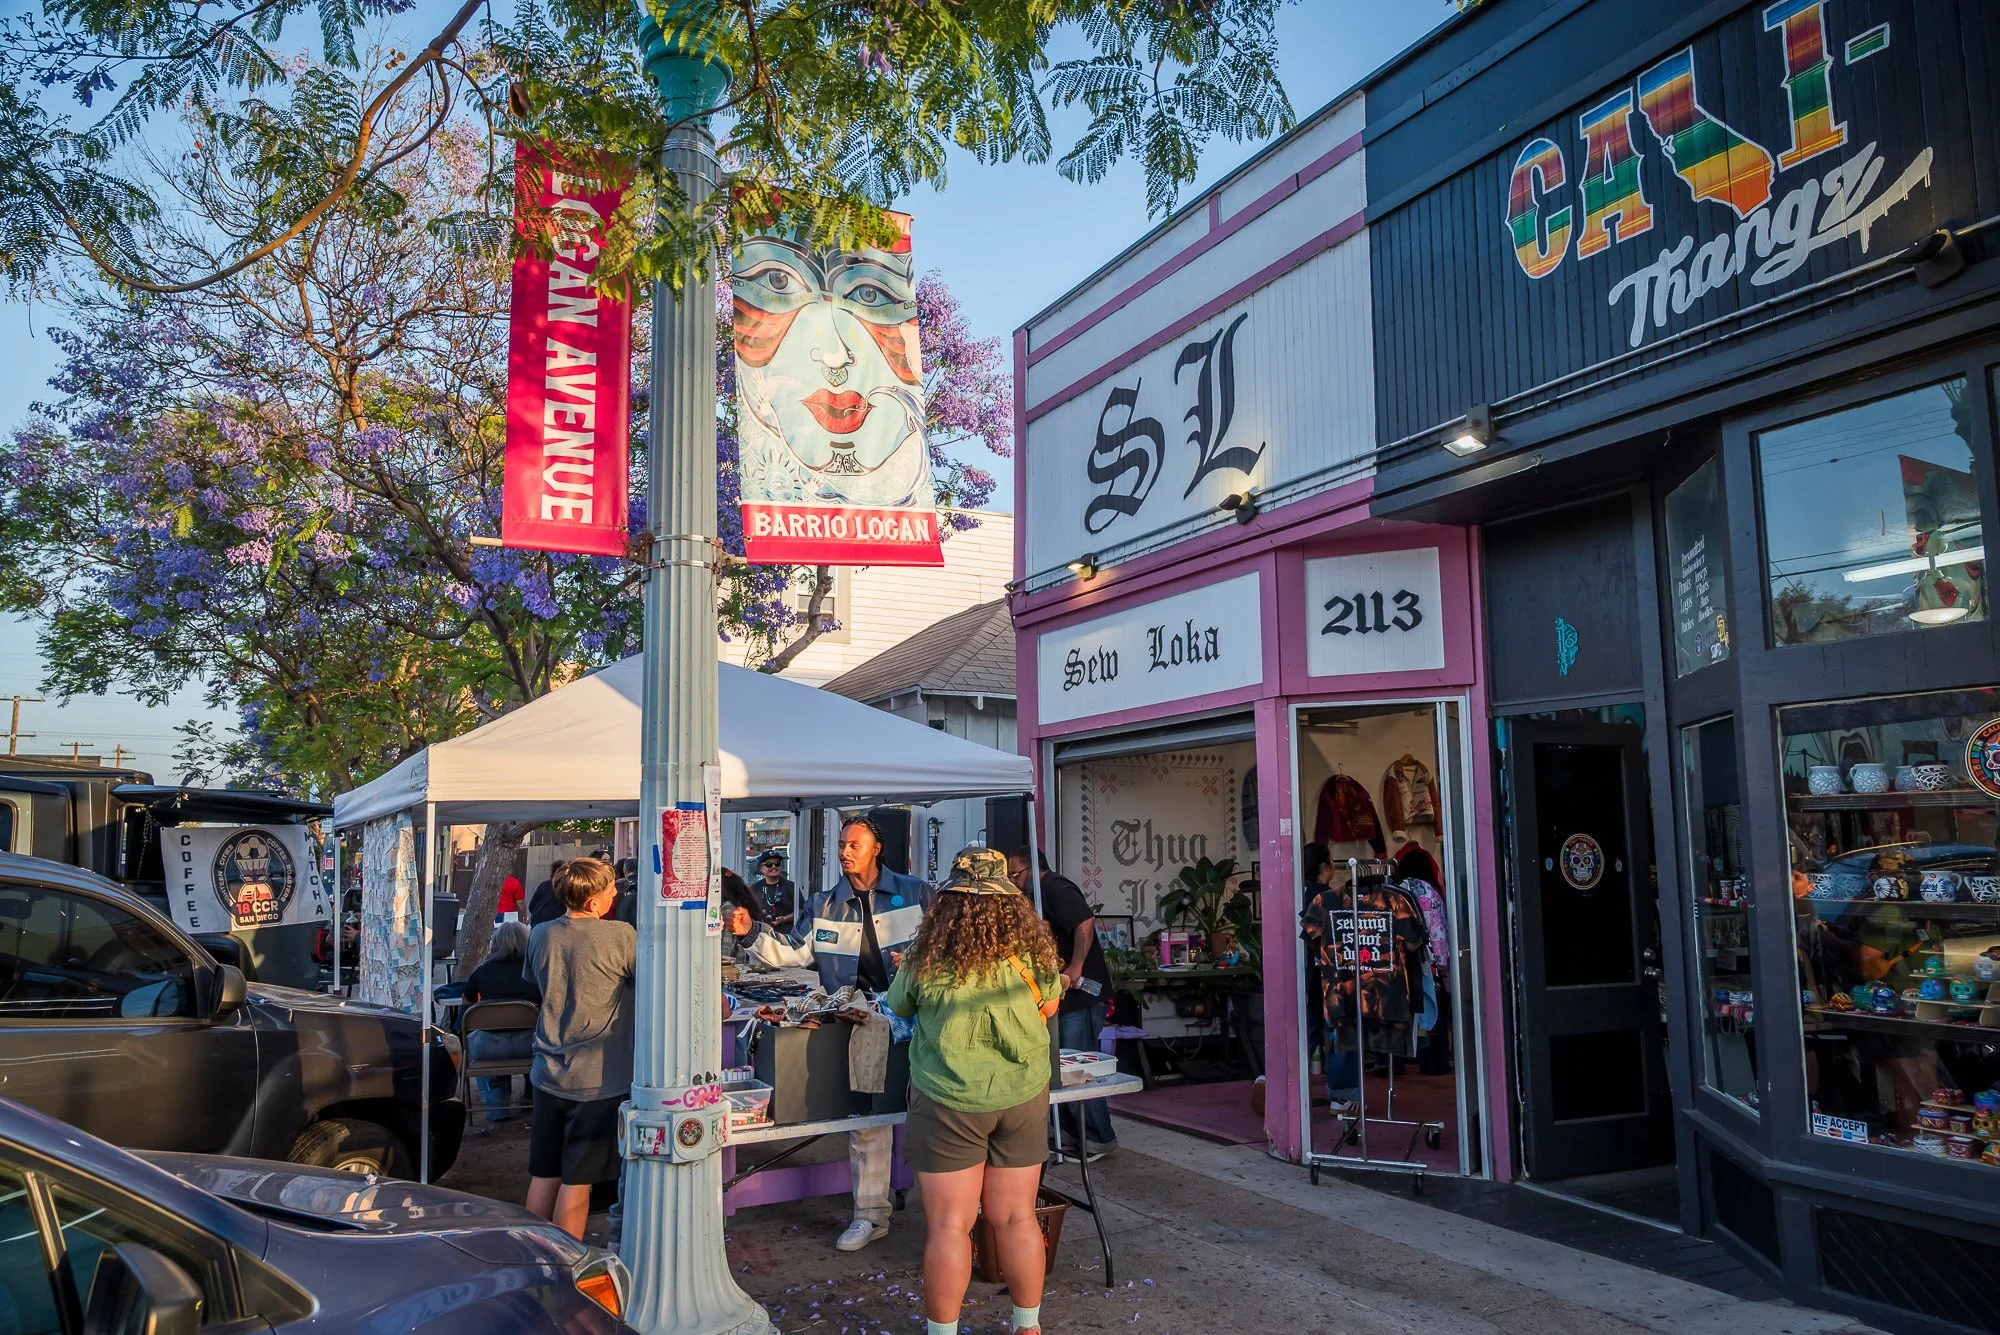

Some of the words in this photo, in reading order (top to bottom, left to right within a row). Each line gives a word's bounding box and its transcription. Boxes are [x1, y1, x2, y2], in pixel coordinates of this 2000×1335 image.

[1608, 142, 1933, 347] Thangz
[541, 336, 598, 525] AVENUE
[1084, 312, 1266, 535] SL
[754, 512, 848, 539] BARRIO
[854, 515, 931, 542] LOGAN
[1321, 589, 1423, 636] 2113
[1063, 645, 1119, 691] Sew
[1146, 618, 1221, 673] Loka
[181, 834, 201, 928] COFFEE
[219, 844, 234, 866] CITIES
[266, 837, 288, 861] COFFEE
[280, 864, 293, 902] ROASTERS
[236, 901, 251, 915] 18
[252, 900, 279, 913] CCR
[239, 915, 255, 924] SAN
[256, 913, 279, 922] DIEGO
[1342, 932, 1354, 944] is
[1813, 1113, 1828, 1126] WE
[1830, 1117, 1866, 1133] ACCEPT
